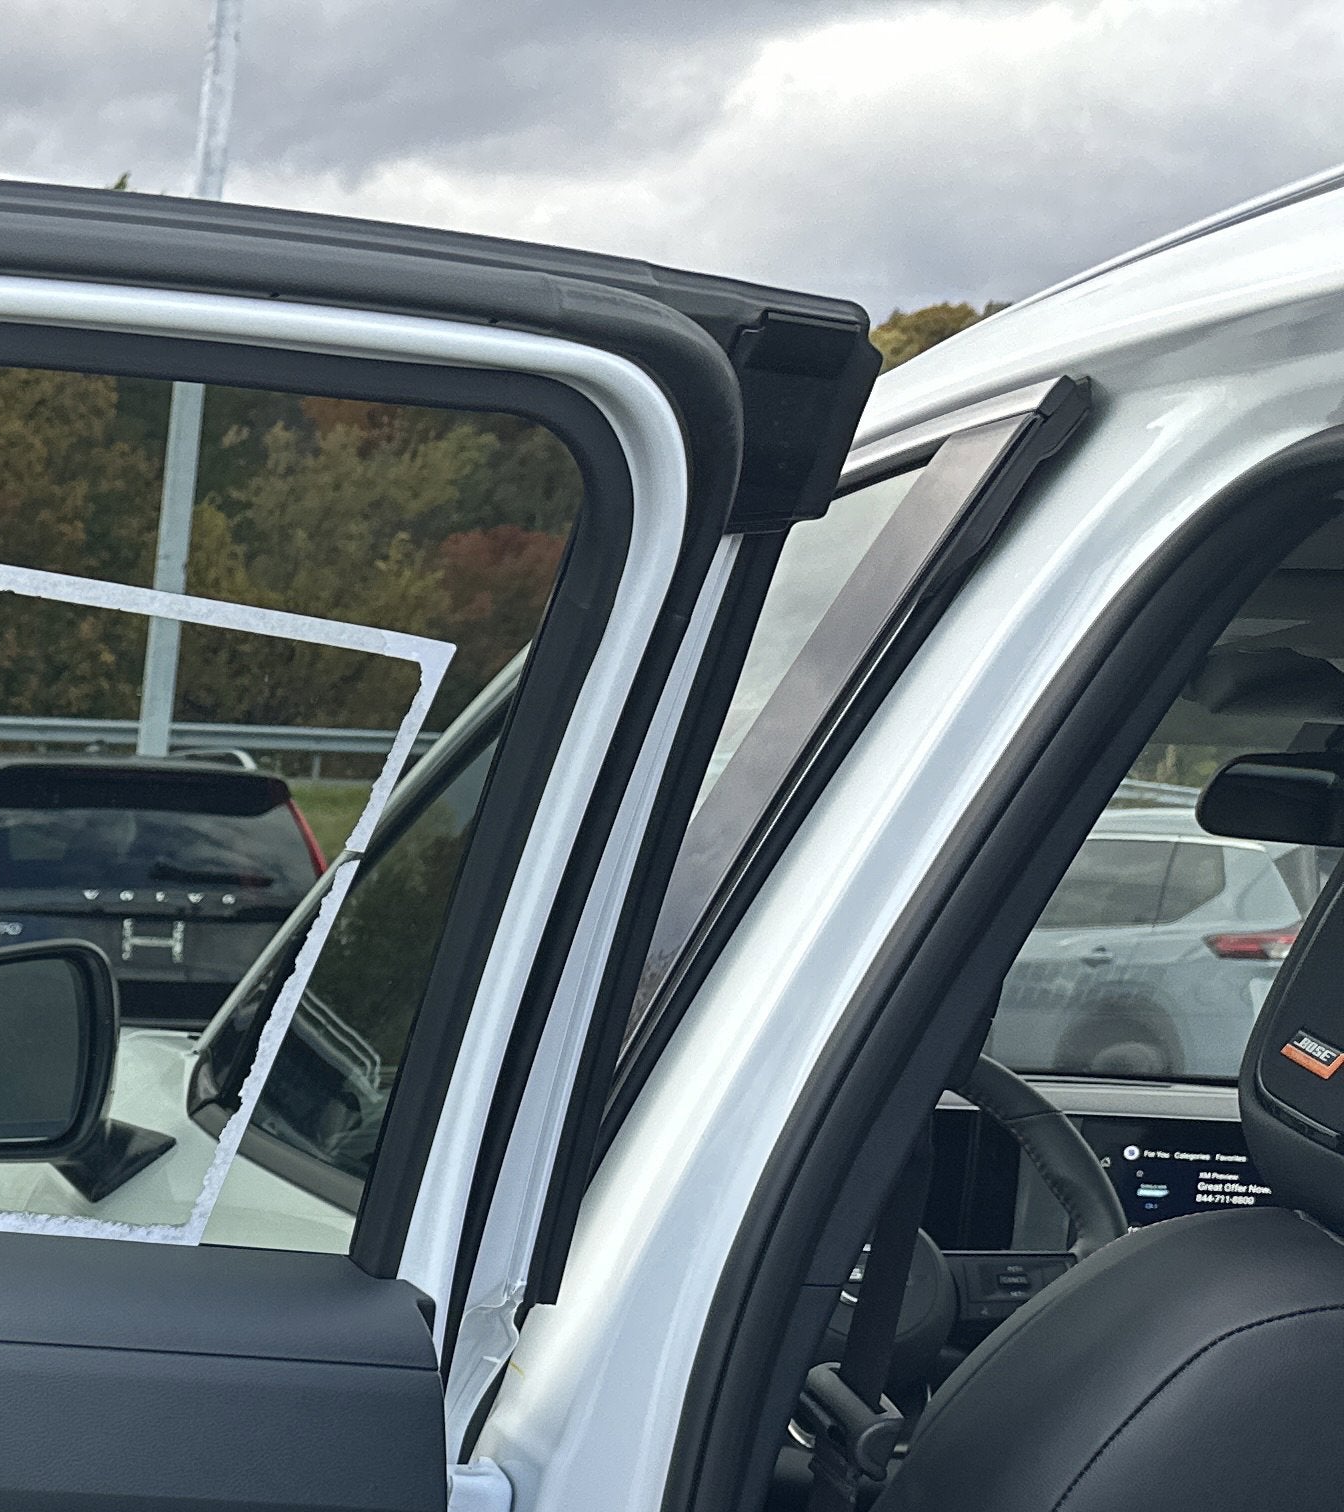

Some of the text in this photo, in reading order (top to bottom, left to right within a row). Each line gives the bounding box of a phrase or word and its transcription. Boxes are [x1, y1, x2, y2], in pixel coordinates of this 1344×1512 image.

[82, 888, 236, 905] VOLVO
[1293, 1037, 1337, 1062] BOSE
[1197, 1181, 1223, 1192] Great
[1224, 1182, 1247, 1193] Offer
